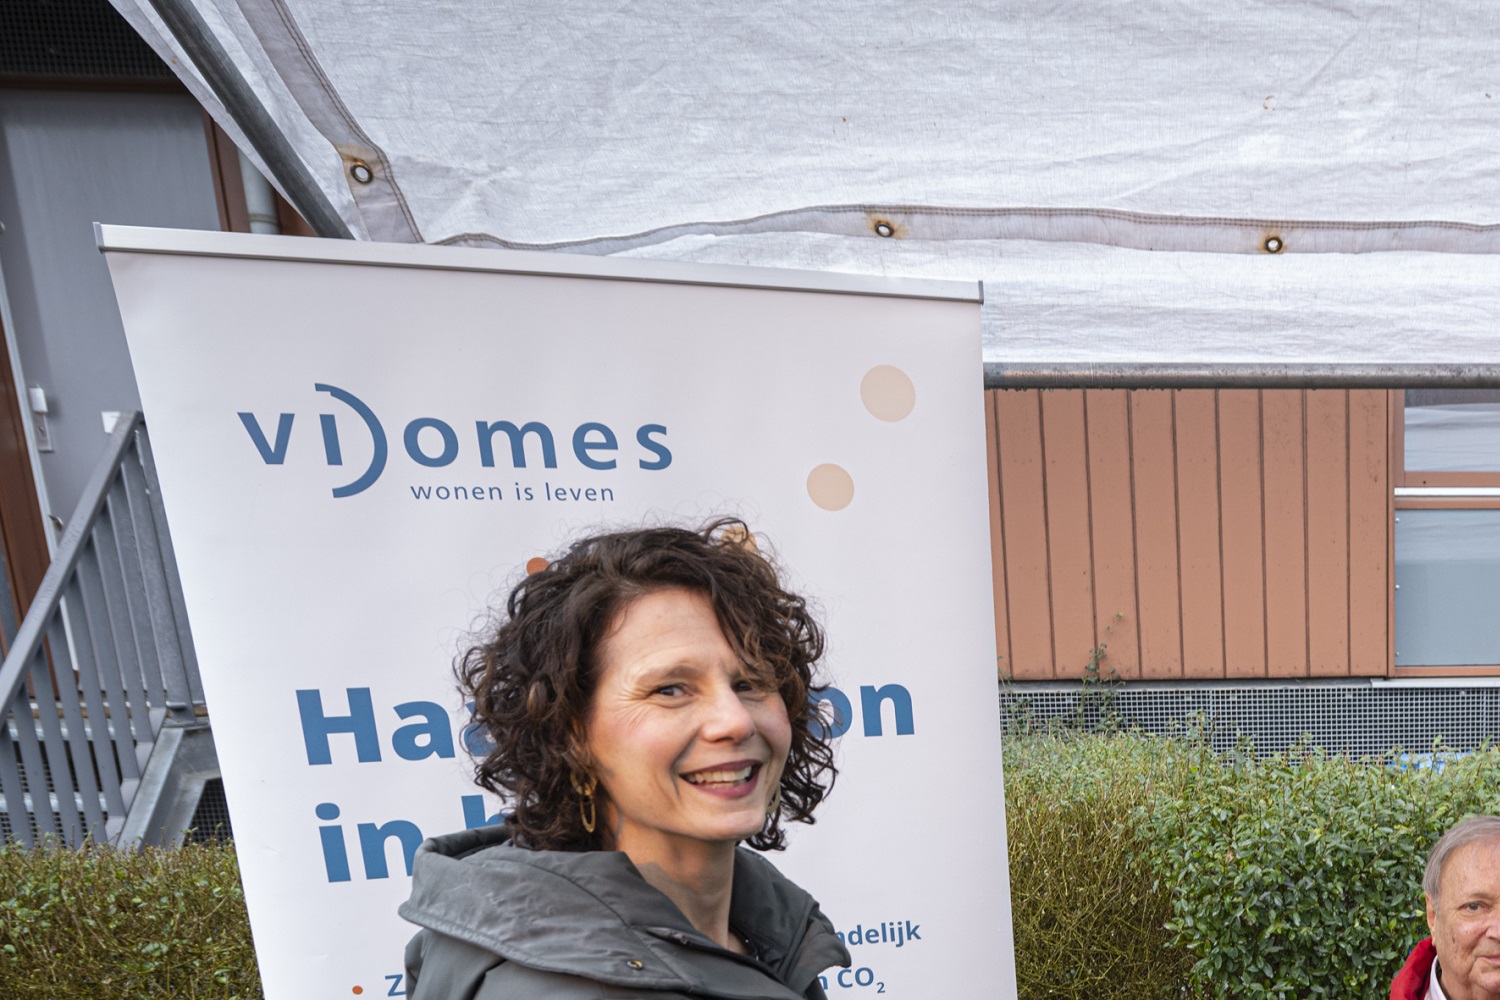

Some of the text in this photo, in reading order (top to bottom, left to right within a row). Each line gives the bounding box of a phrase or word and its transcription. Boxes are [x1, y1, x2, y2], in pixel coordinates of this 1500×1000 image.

[410, 482, 615, 502] wonen is leven
[806, 683, 915, 739] on
[315, 802, 424, 883] in
[834, 920, 922, 947] delijk
